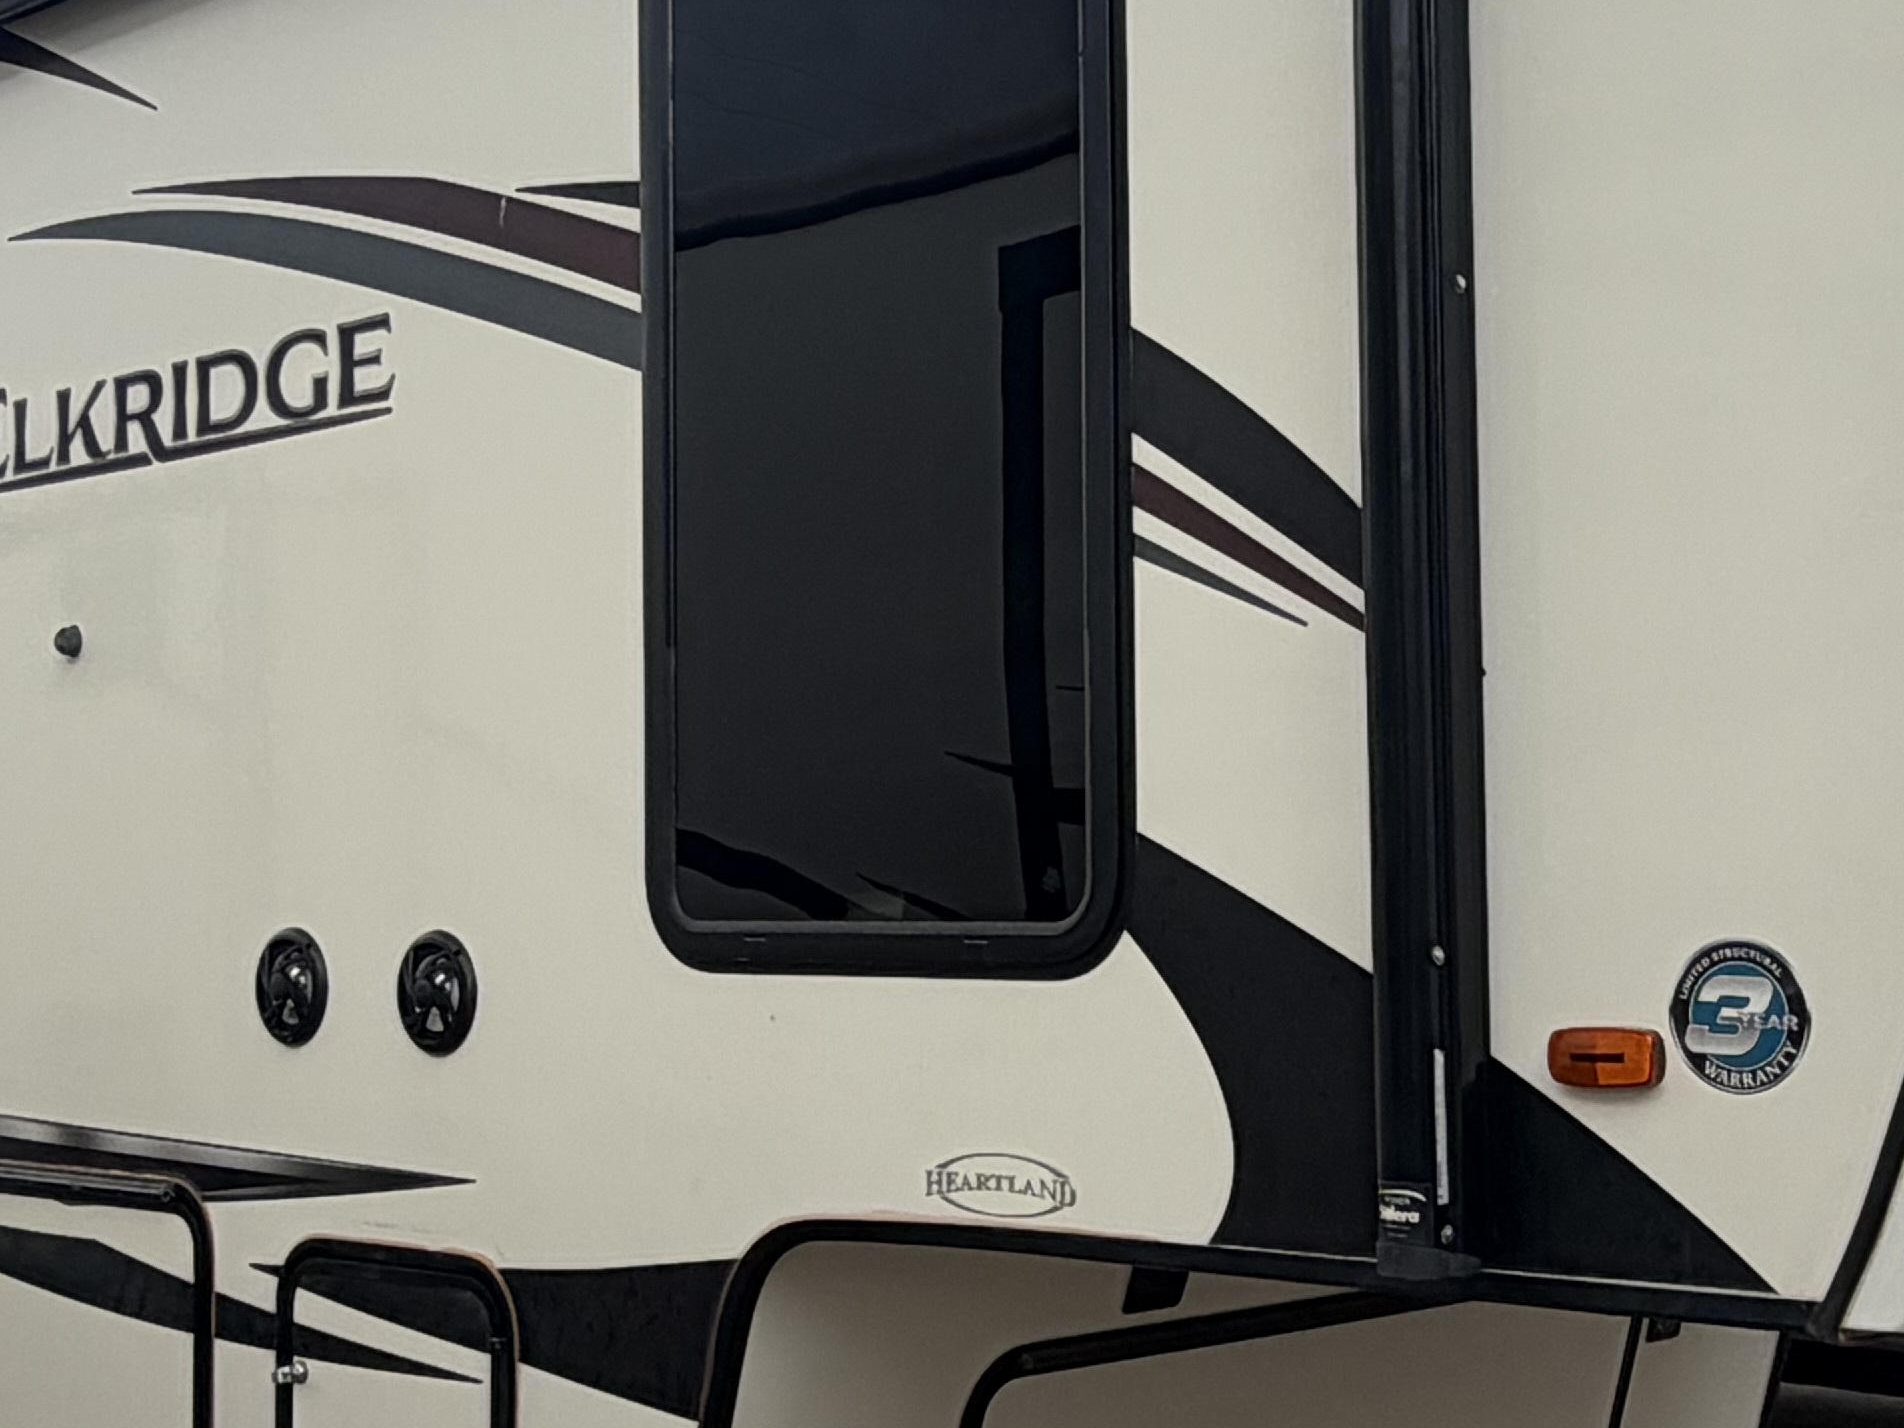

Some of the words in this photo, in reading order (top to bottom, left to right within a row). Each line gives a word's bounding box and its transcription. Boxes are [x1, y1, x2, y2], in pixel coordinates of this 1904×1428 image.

[1684, 974, 1774, 1056] 3
[1737, 1011, 1799, 1032] YEAR
[1704, 1040, 1798, 1088] WARRANTY
[925, 1170, 1077, 1207] HEARTLAND
